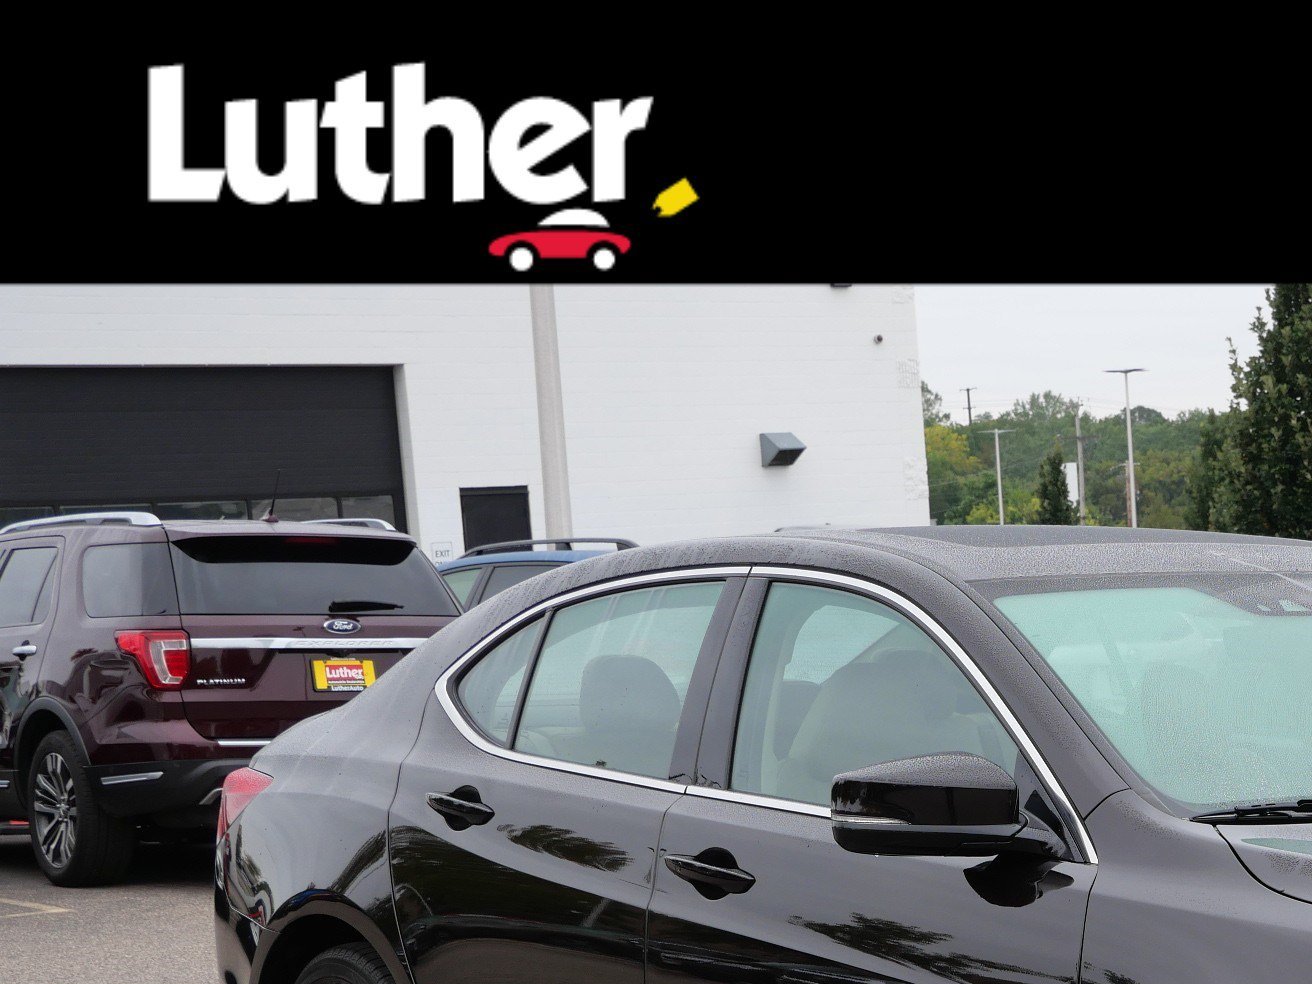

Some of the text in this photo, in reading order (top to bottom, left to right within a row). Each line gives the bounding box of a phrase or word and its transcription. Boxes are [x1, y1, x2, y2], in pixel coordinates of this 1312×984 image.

[434, 549, 450, 558] EXIT
[333, 621, 353, 630] Ford
[326, 666, 363, 678] Luther
